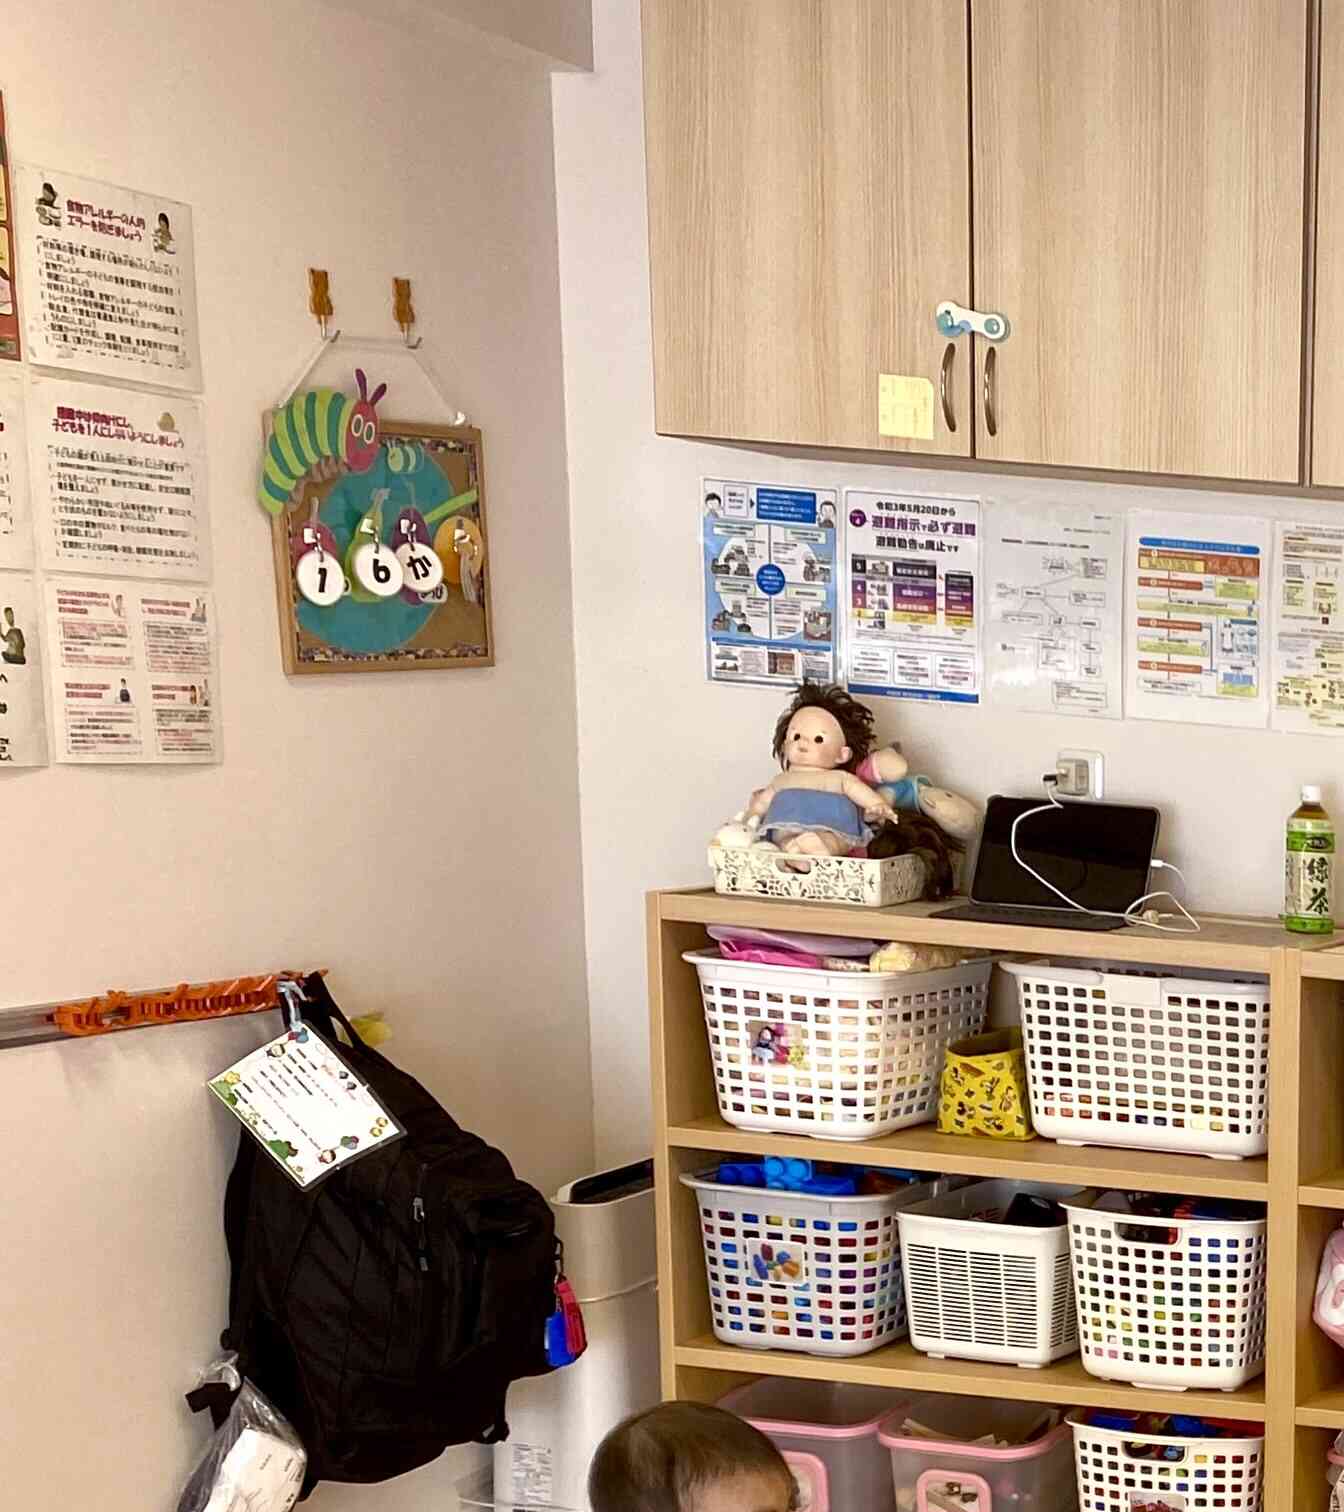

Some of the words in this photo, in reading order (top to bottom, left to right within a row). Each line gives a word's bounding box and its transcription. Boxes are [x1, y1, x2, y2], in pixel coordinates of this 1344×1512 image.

[318, 567, 328, 593] 1
[373, 559, 391, 583] 6
[406, 555, 433, 581] か
[1306, 857, 1328, 915] 緑茶
